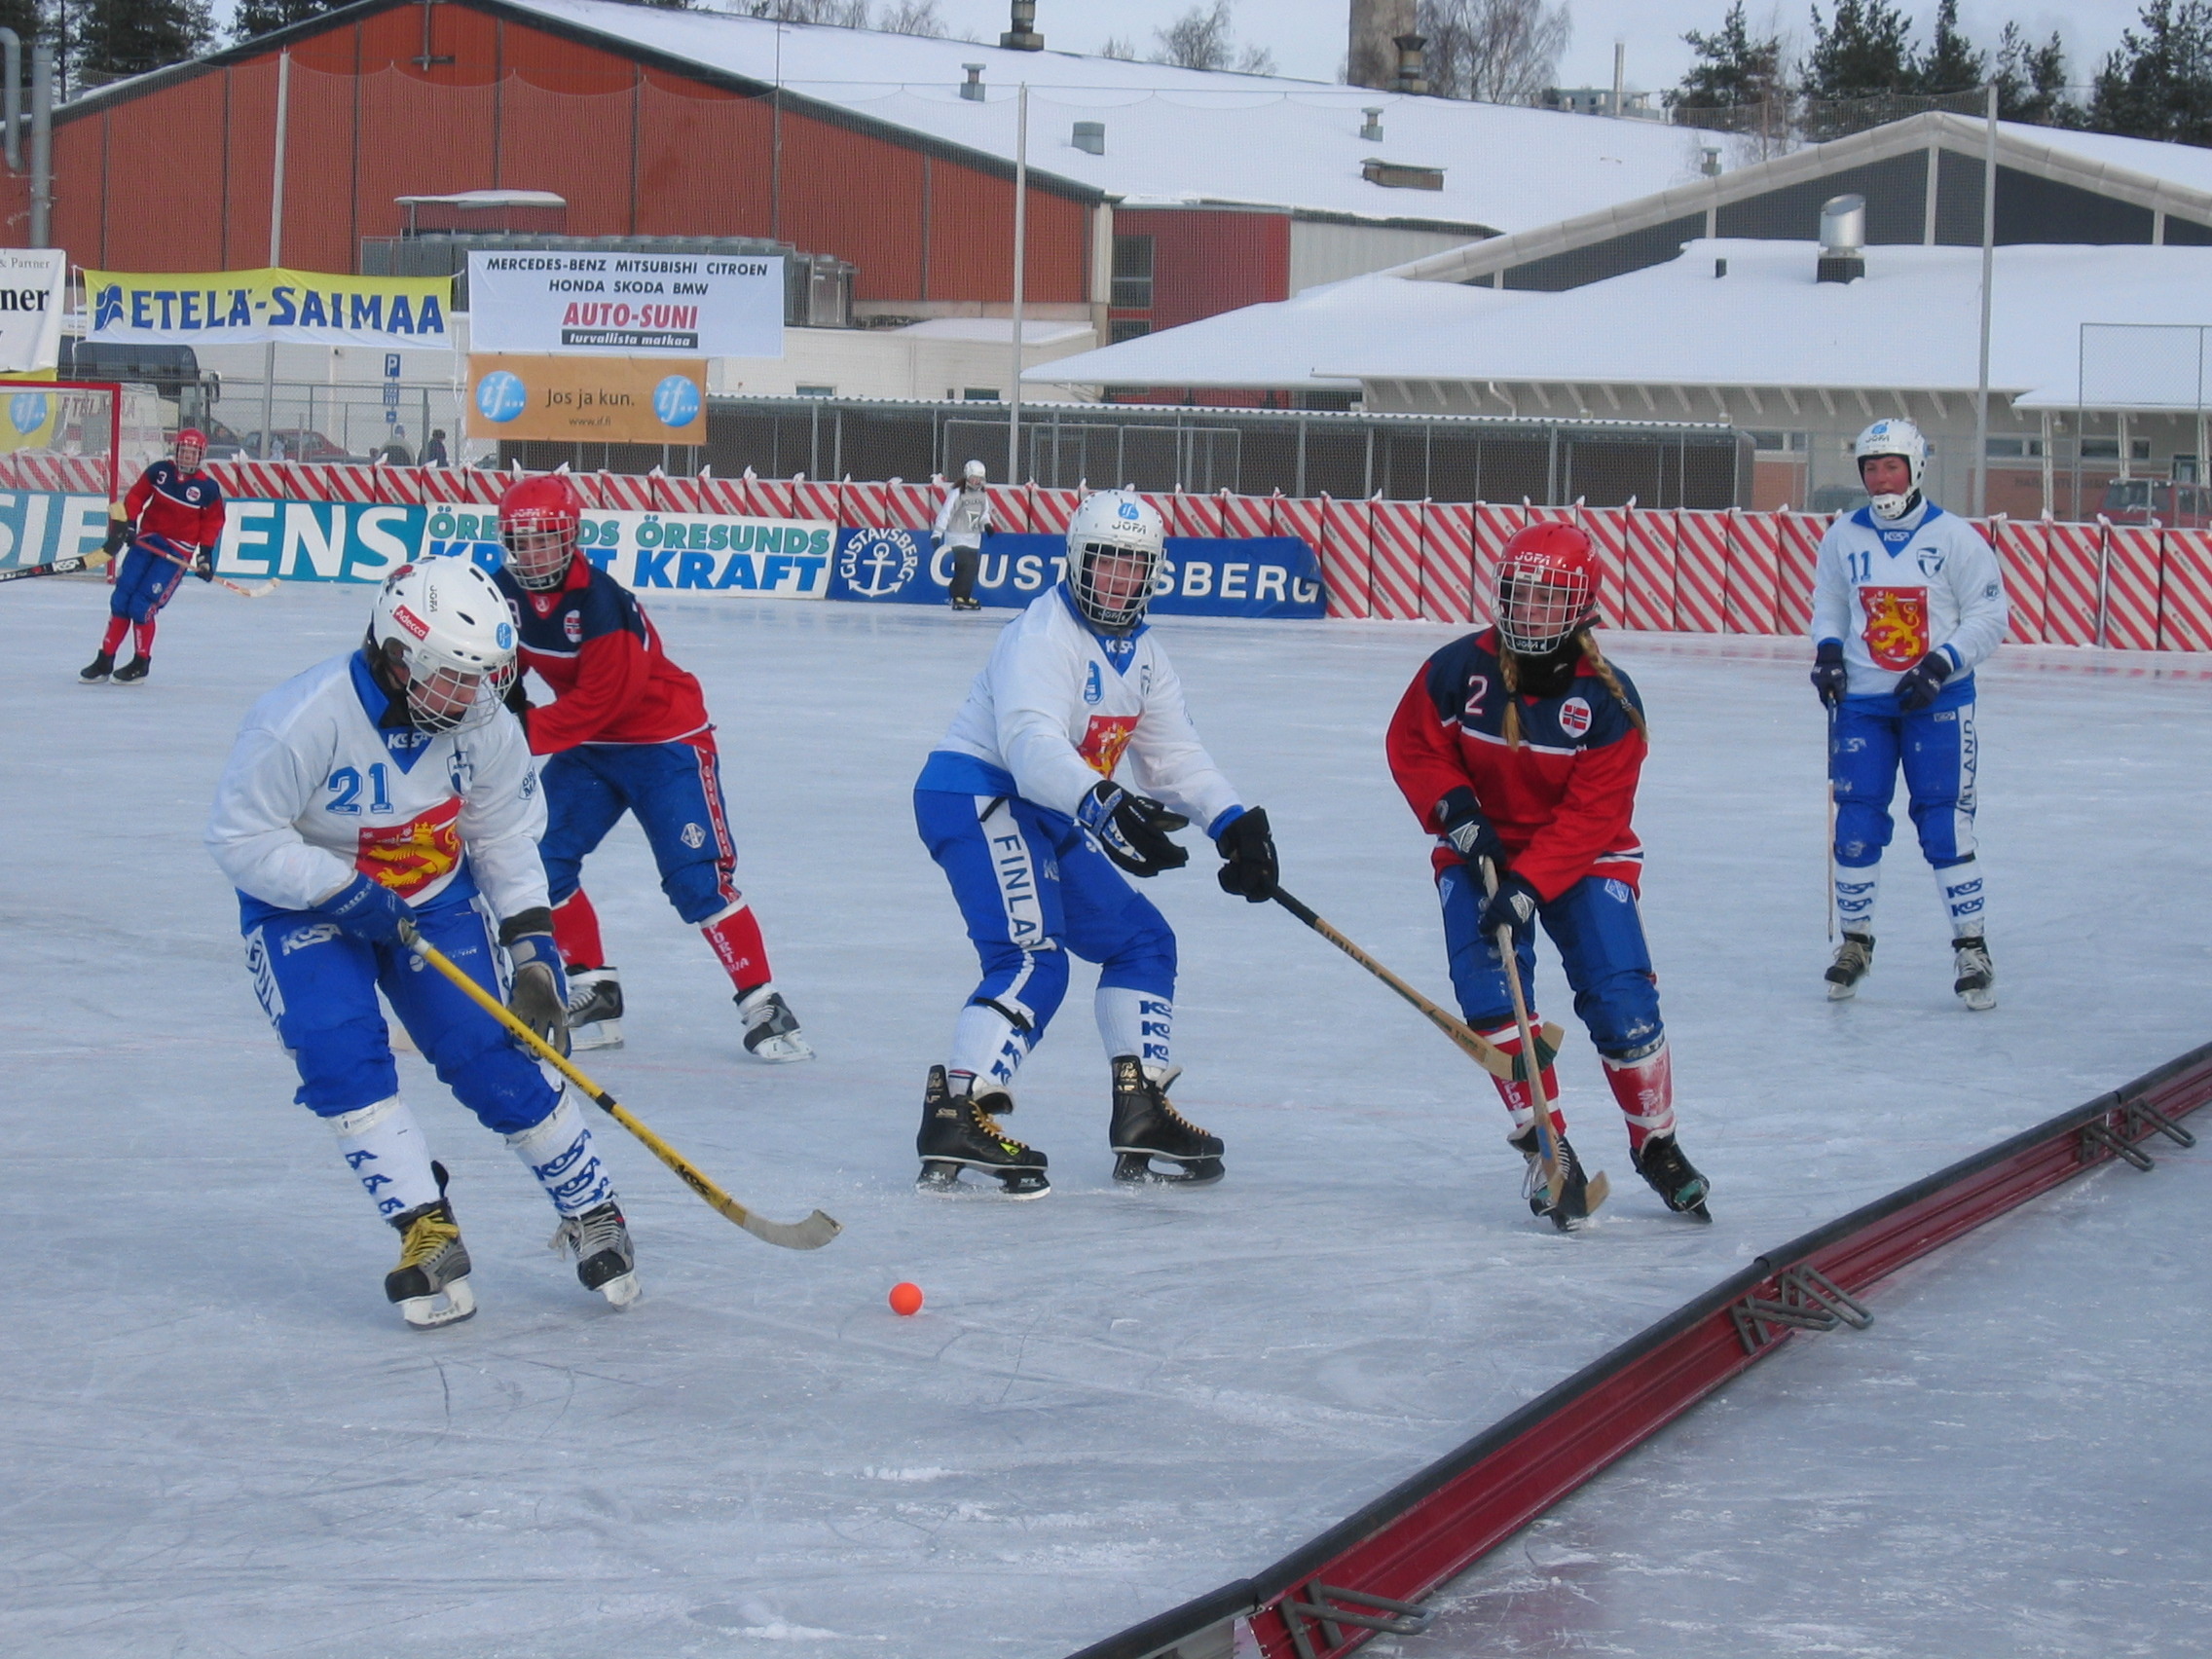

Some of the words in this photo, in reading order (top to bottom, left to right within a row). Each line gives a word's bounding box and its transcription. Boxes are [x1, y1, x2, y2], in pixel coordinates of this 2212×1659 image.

[11, 257, 50, 269] Partner
[487, 257, 607, 272] MERCEDES-BENZ
[614, 259, 698, 275] MITSUBISHI
[706, 262, 768, 276] CITROEN
[549, 278, 605, 293] HONDA
[613, 279, 665, 294] SKODA
[673, 281, 709, 295] BMW
[130, 286, 444, 335] ETELÄ-SAIMAA
[562, 302, 699, 330] AUTO-SUNI
[570, 332, 638, 345] turvallista
[642, 333, 690, 347] matkaa
[545, 388, 572, 408] Jos
[576, 387, 593, 409] ja
[599, 387, 635, 406] kun.
[156, 470, 167, 485] 3
[636, 514, 830, 555] ÖRESUNDS
[1112, 521, 1147, 535] JOFA
[633, 550, 827, 591] KRAFT
[1515, 551, 1551, 566] JOFA
[1848, 551, 1871, 584] 11
[930, 545, 1319, 603] GUSTSBERG
[394, 609, 426, 638] Adecco
[1464, 675, 1488, 715] 2
[326, 762, 393, 816] 21
[992, 834, 1037, 940] FINLA
